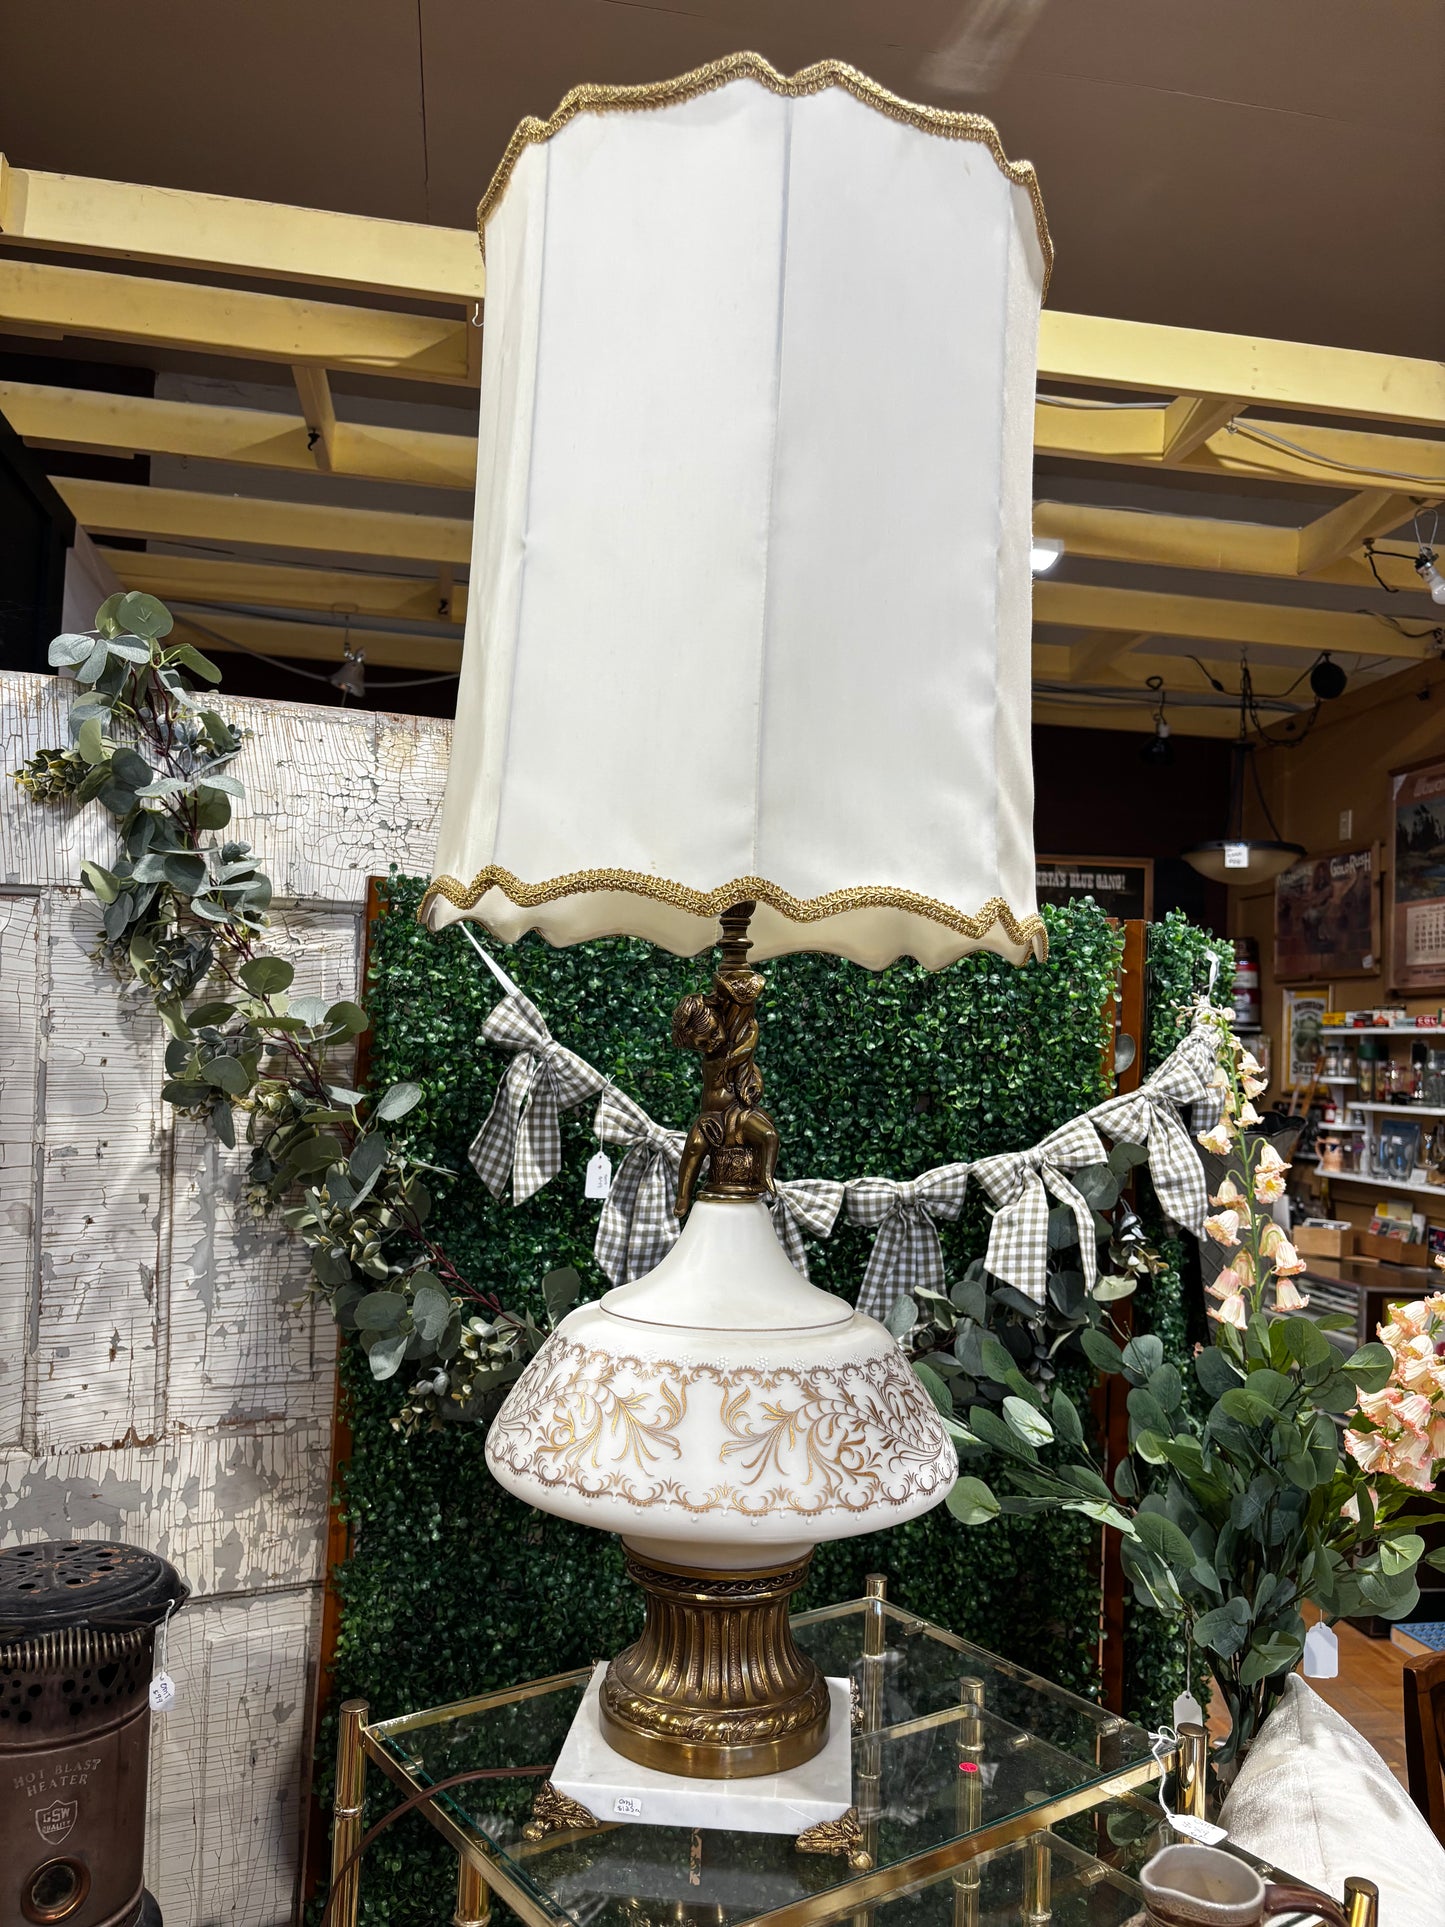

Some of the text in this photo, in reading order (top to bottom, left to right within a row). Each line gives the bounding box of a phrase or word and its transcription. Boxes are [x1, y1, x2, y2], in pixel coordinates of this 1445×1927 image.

[1068, 872, 1095, 889] BLUE
[1096, 873, 1126, 890] GANG!
[13, 1758, 102, 1790] HOT BLAST
[26, 1774, 88, 1798] HEATER
[42, 1807, 71, 1823] GSW
